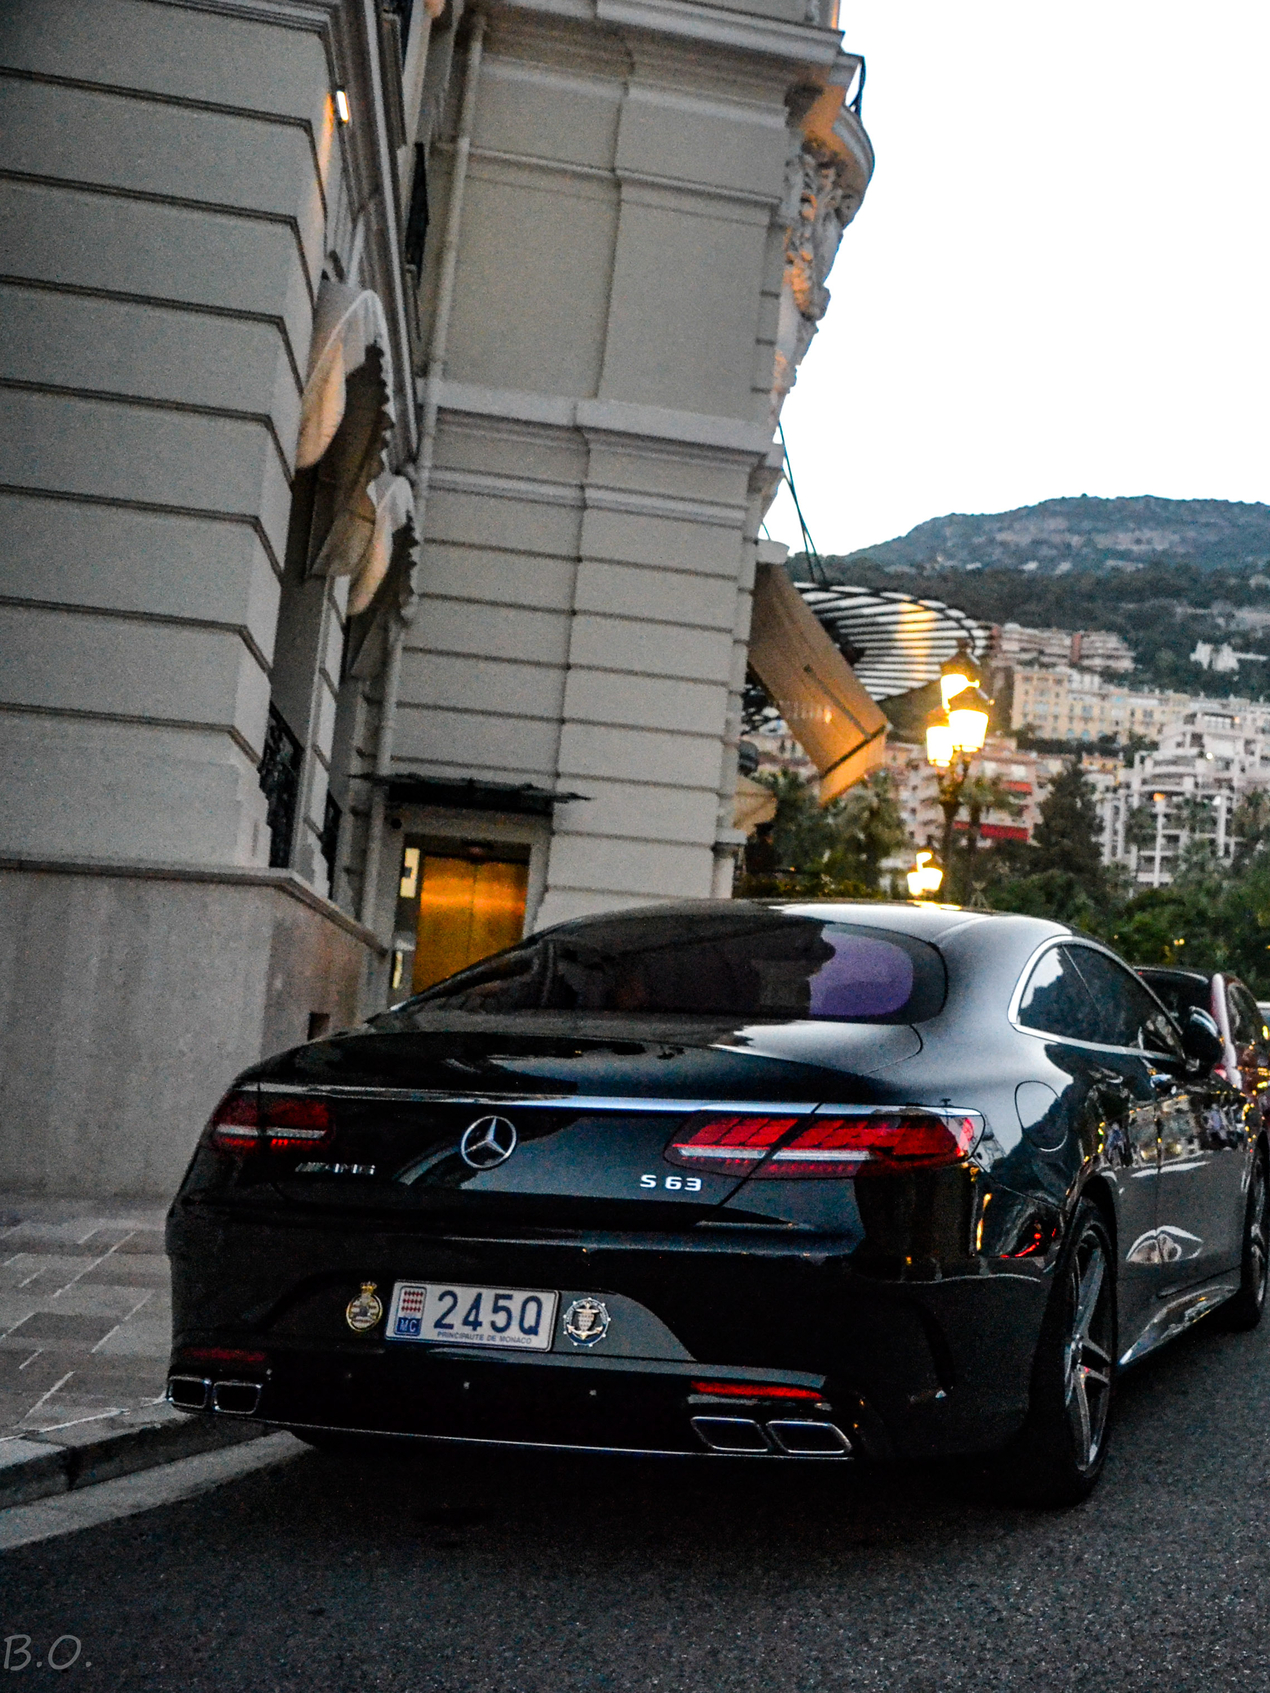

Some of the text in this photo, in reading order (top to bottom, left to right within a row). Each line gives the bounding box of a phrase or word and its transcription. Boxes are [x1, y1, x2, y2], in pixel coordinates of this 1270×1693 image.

[639, 1174, 702, 1191] S 63
[433, 1290, 543, 1336] 245Q
[399, 1319, 418, 1332] MC
[437, 1331, 533, 1345] PRINCIPAUTE DE MONACO
